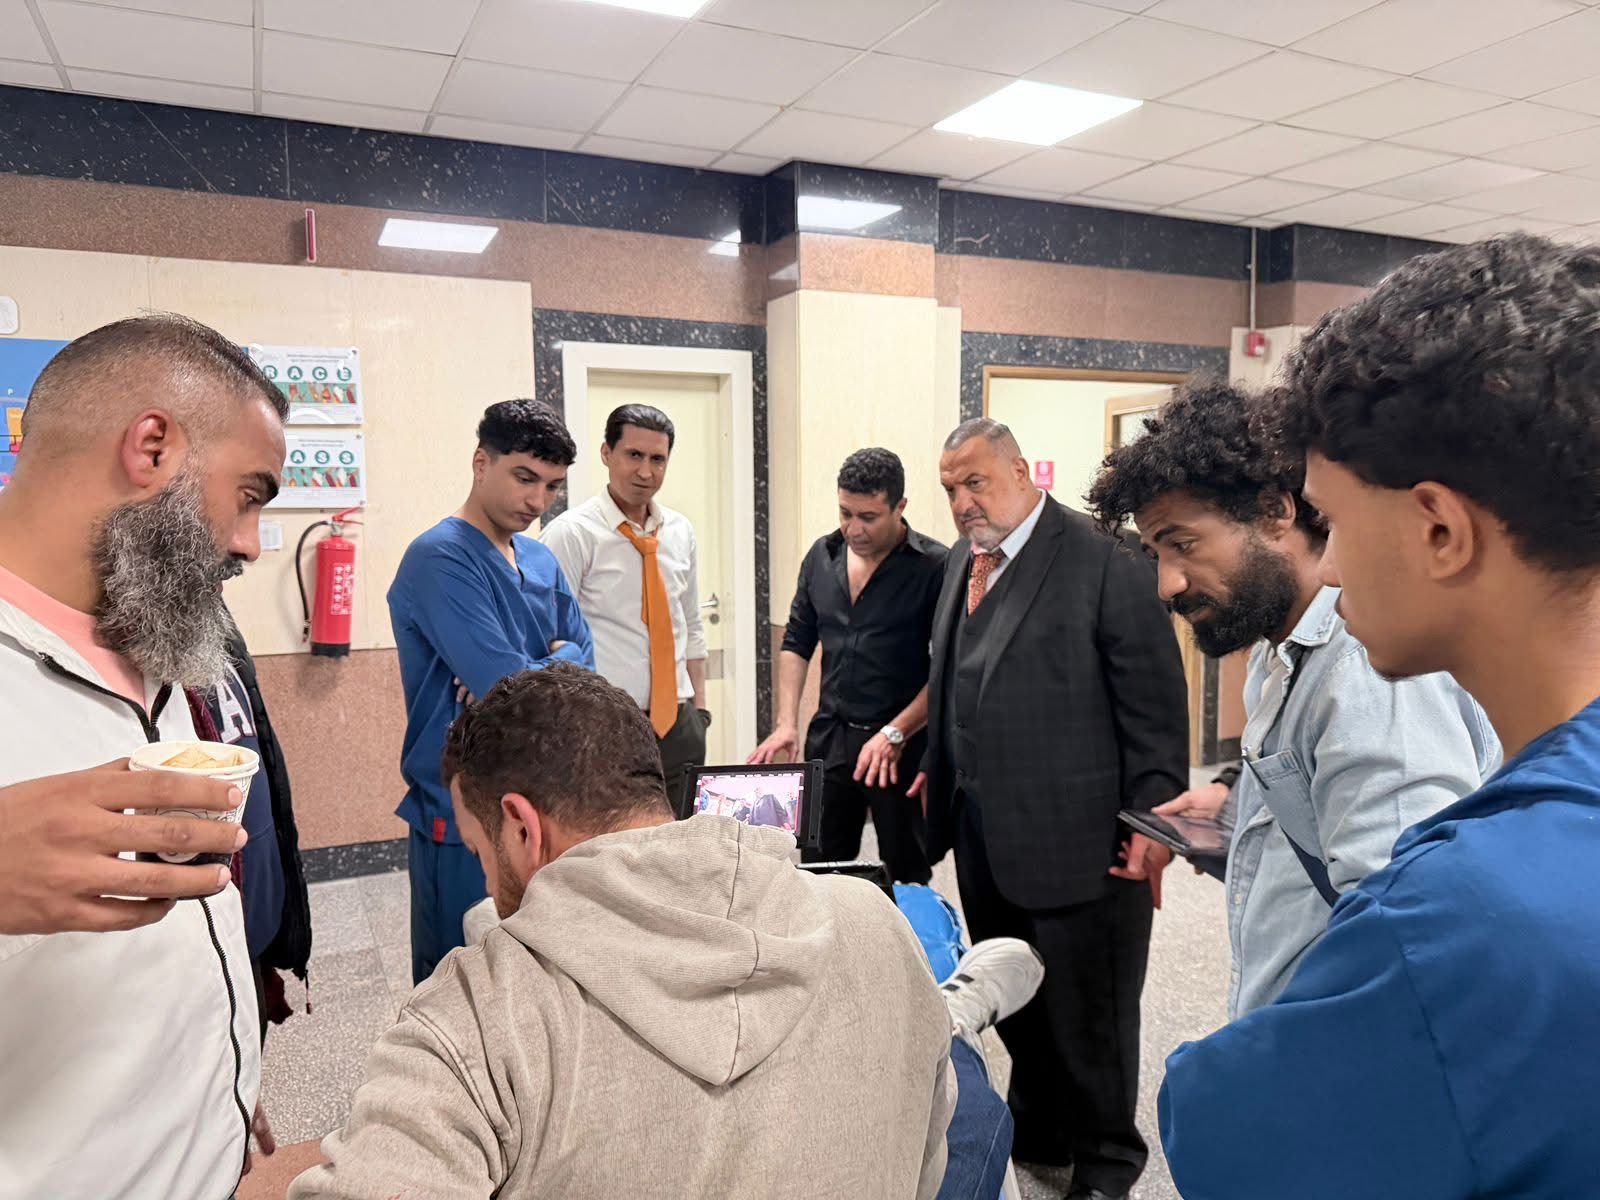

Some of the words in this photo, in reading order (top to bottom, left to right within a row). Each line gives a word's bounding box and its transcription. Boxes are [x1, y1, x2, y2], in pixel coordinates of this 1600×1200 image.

[264, 365, 275, 379] R
[288, 366, 301, 379] A
[314, 368, 326, 380] C
[292, 451, 304, 463] A
[317, 452, 328, 463] S
[341, 452, 353, 463] S
[215, 680, 254, 744] A
